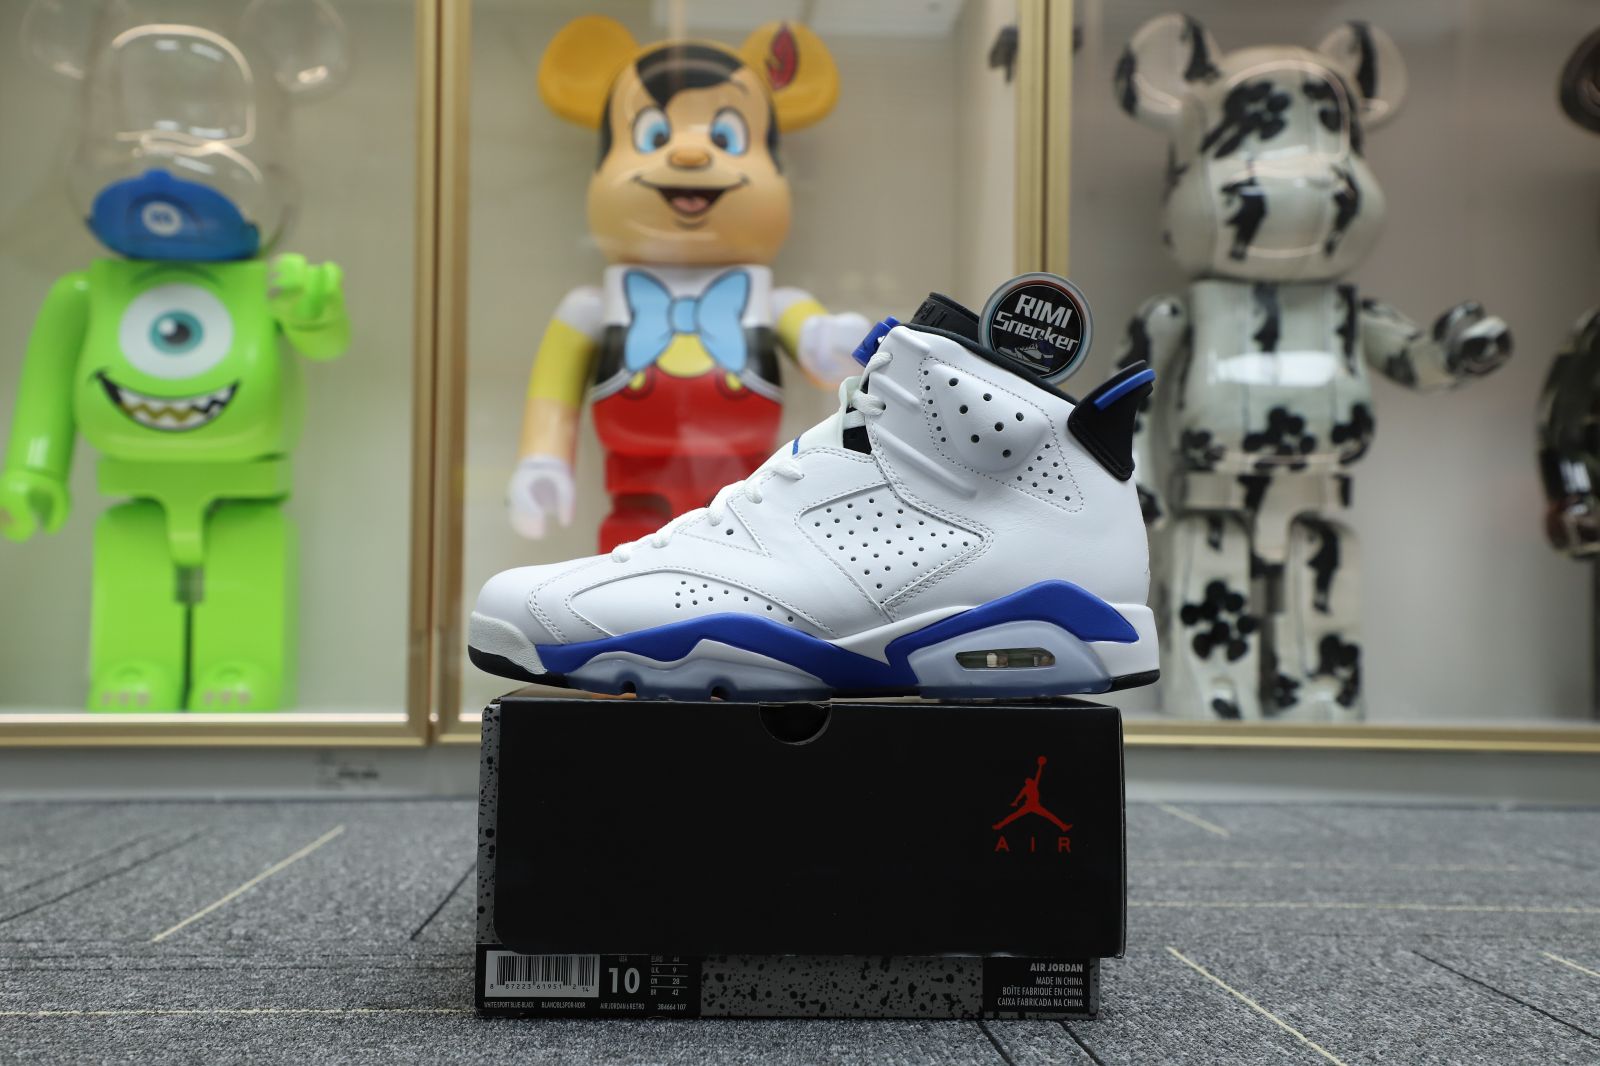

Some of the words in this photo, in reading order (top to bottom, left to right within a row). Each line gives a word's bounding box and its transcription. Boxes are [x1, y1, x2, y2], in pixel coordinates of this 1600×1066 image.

[1014, 294, 1073, 329] RIMI
[672, 966, 678, 974] 9
[1030, 963, 1046, 972] AIR
[1047, 963, 1083, 973] JORDAN
[608, 967, 641, 994] 10
[672, 977, 680, 985] 28
[1036, 976, 1054, 985] MADE
[1055, 976, 1062, 985] IN
[1063, 976, 1083, 986] CHINA
[1022, 985, 1053, 996] FABRIQUÉ
[1054, 987, 1063, 996] EN
[1063, 987, 1083, 997] CHINA
[997, 997, 1016, 1006] CAIXA
[1017, 997, 1052, 1007] FABRICADA
[1053, 998, 1063, 1007] NA
[1063, 998, 1083, 1007] CHINA
